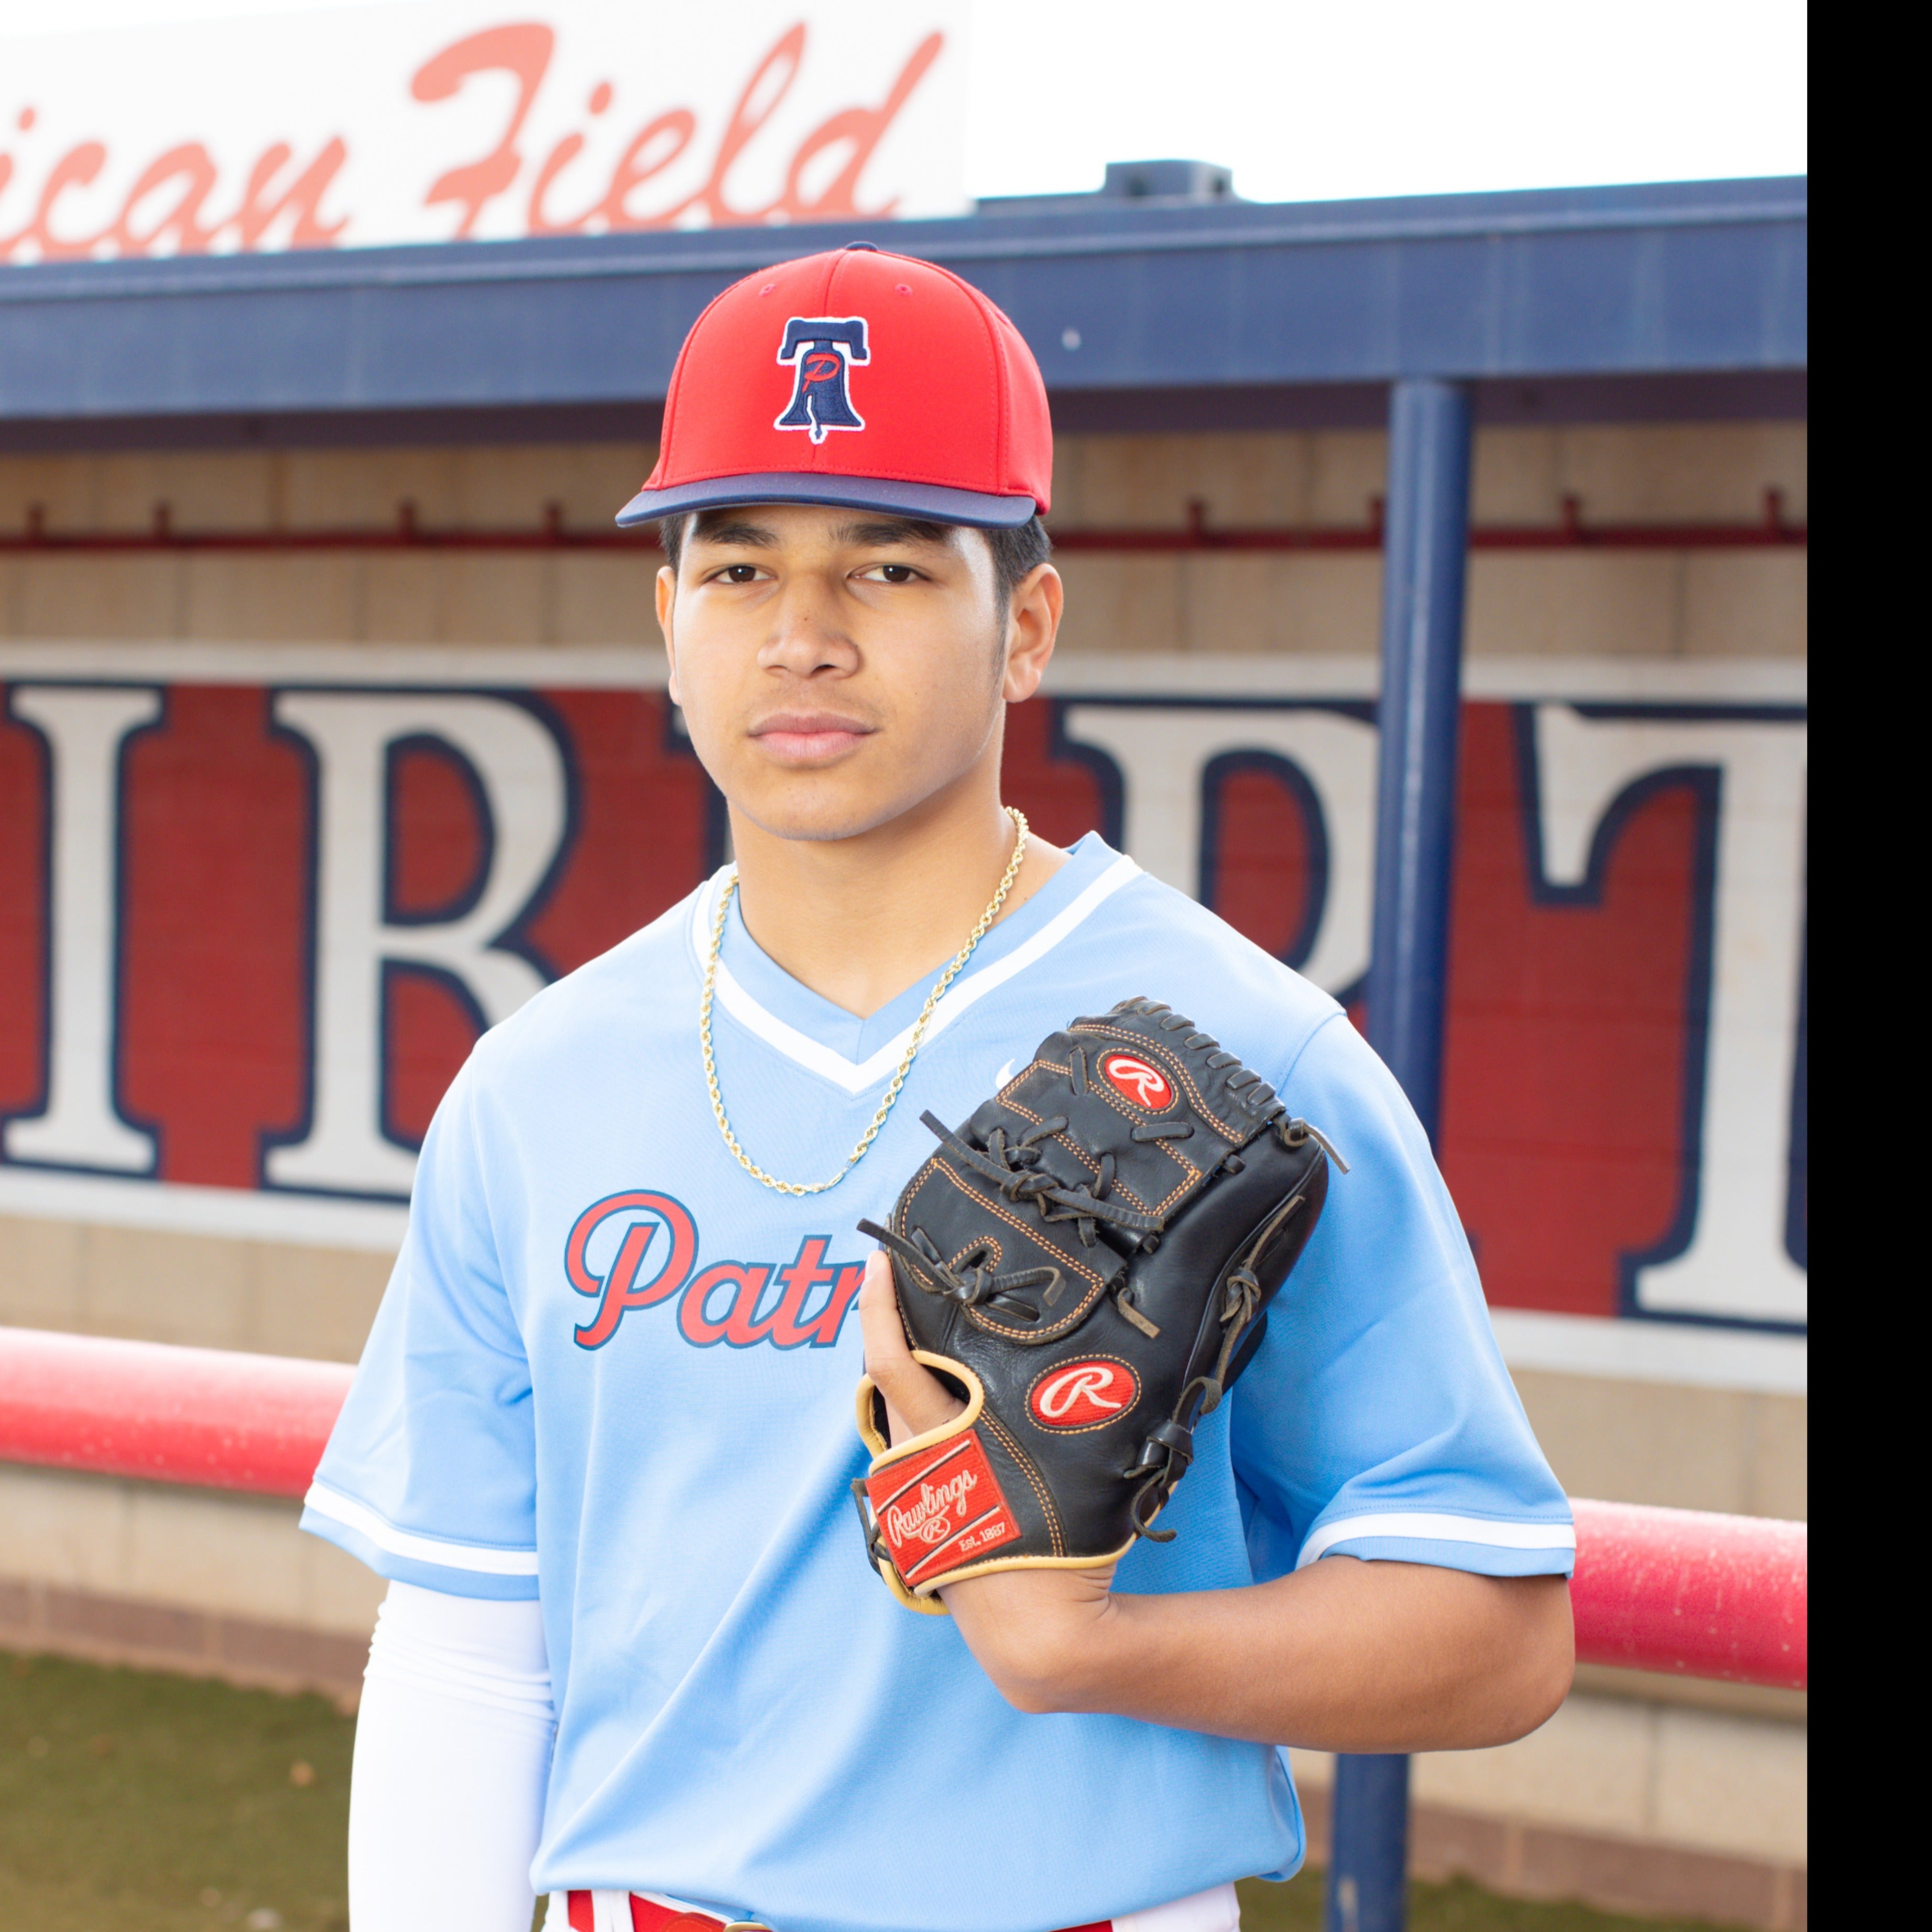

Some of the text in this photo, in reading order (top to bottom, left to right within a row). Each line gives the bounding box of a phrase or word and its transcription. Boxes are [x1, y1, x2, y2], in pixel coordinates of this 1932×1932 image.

[409, 20, 945, 242] Field
[802, 353, 841, 393] P
[1109, 1058, 1164, 1108] R
[1039, 1367, 1122, 1418] R
[887, 1469, 978, 1548] Rawlings
[958, 1522, 1006, 1552] Est. 1887
